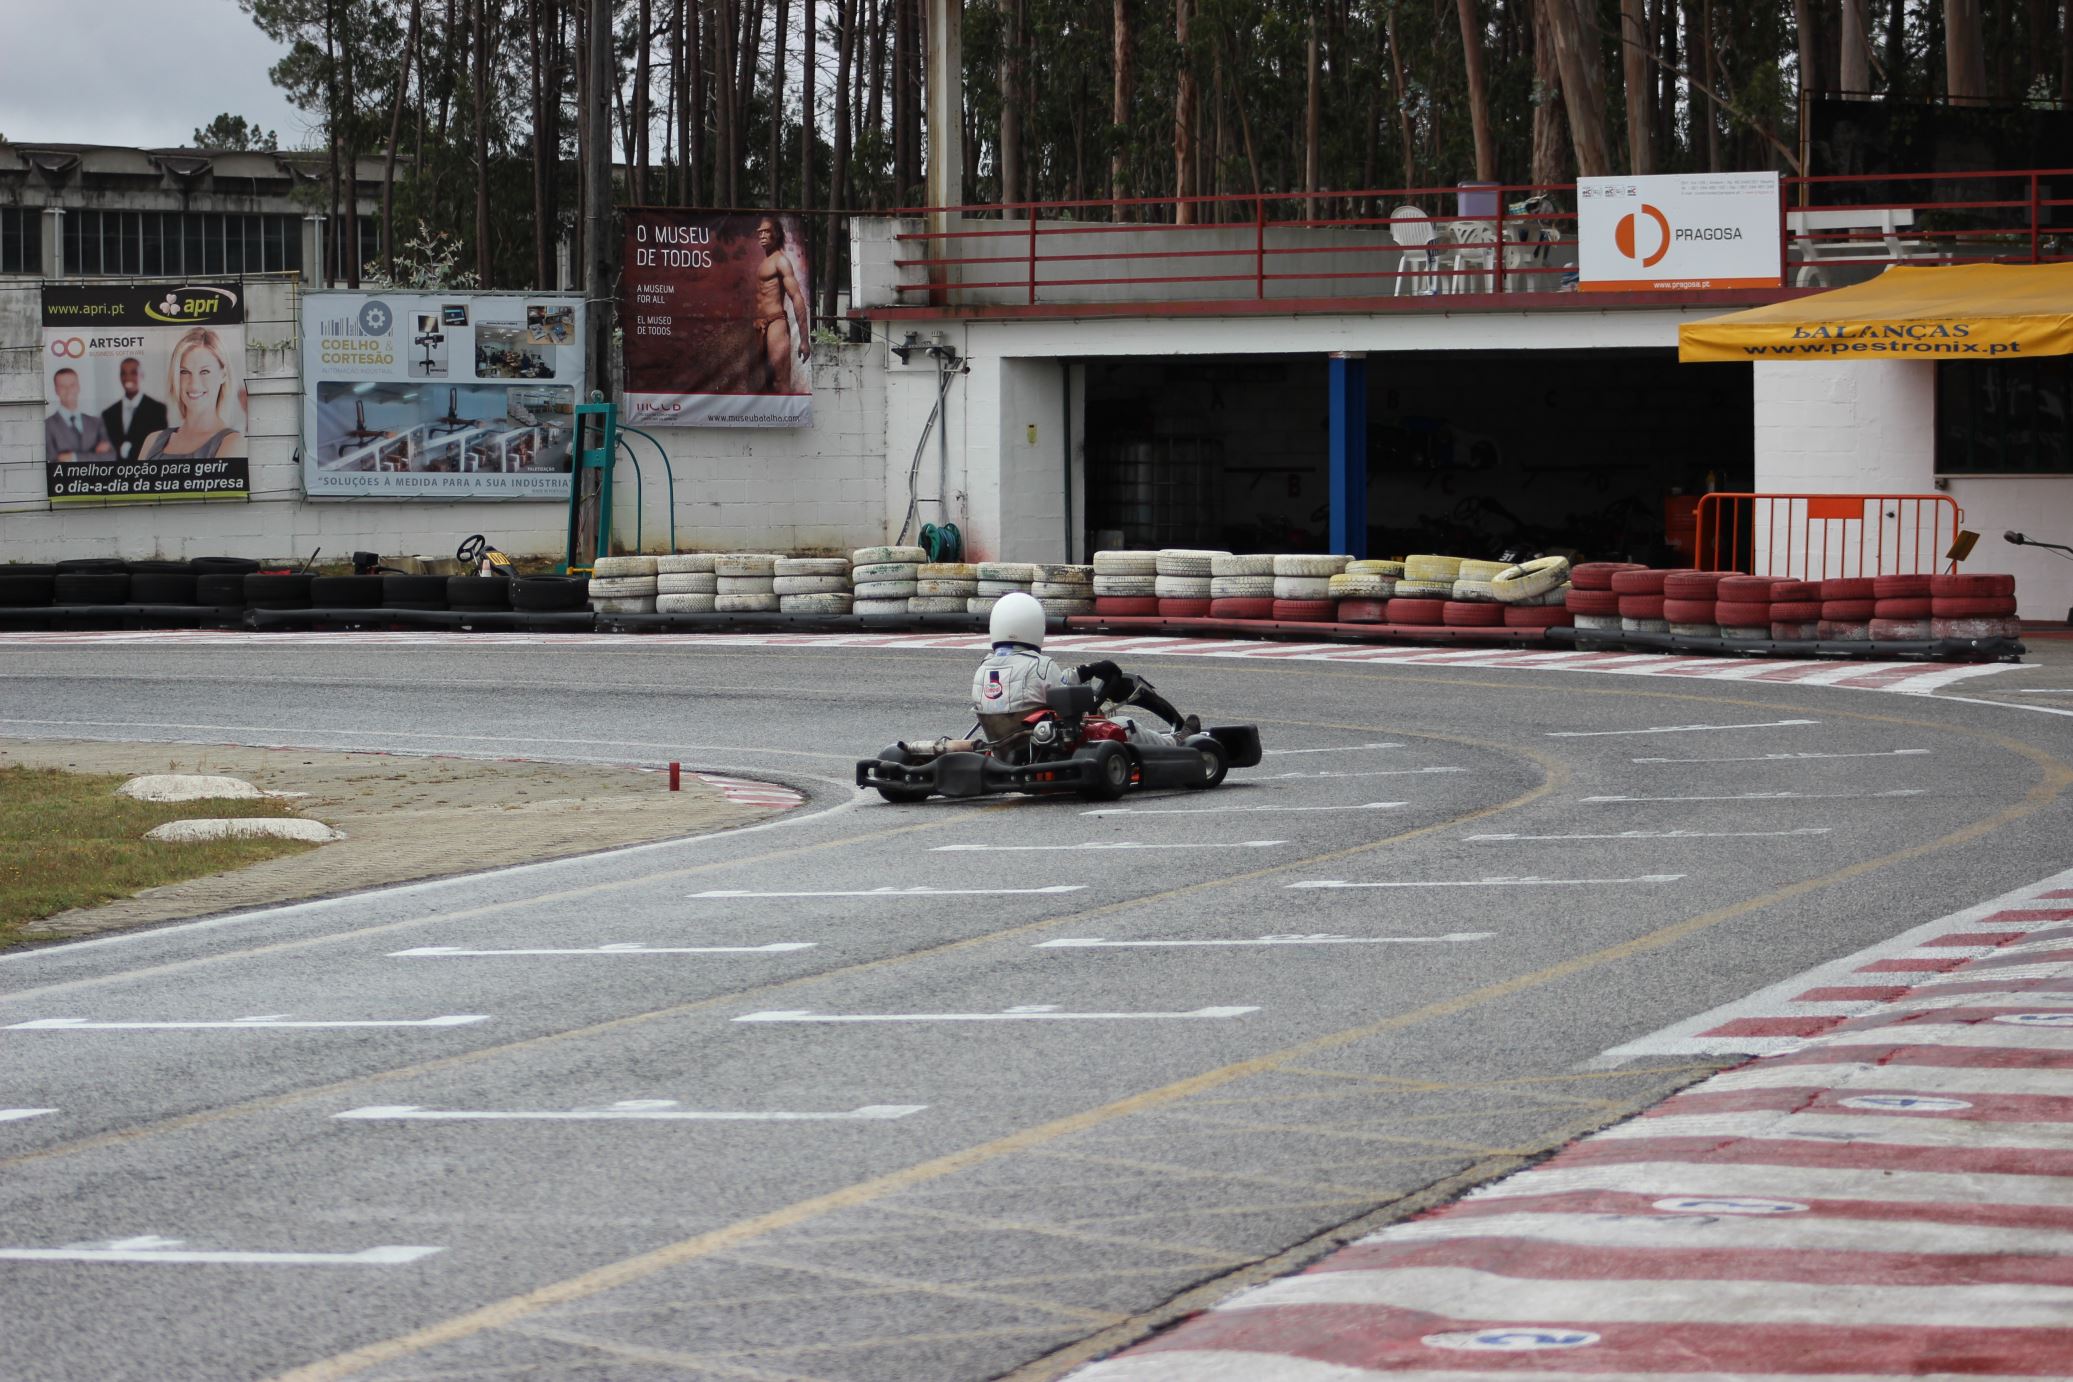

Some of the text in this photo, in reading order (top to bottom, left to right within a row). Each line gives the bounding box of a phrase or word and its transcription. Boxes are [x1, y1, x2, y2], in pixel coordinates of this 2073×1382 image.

[637, 225, 709, 244] O MUSEU
[1675, 227, 1742, 241] PRAGOSA
[637, 249, 712, 268] DE TODOS
[637, 284, 675, 294] A MUSEUM
[1653, 281, 1711, 289] www.pragosa.pt
[183, 294, 219, 317] apri
[637, 295, 665, 304] FOR ALL
[48, 303, 124, 317] www.apri.pt
[637, 316, 672, 325] EL MUSEO
[637, 327, 672, 336] DE TODOS
[89, 336, 144, 348] ARTSOFT
[321, 339, 380, 351] COELHO
[1744, 341, 2021, 355] www.pestronix.pt
[321, 351, 394, 365] CORTESÃO
[53, 460, 229, 478] A melhor opção para gerir
[55, 477, 244, 494] o dia-a-dia da sua empresa
[384, 476, 391, 486] À
[396, 478, 438, 487] MEDIDA
[443, 478, 470, 487] PARA
[475, 478, 483, 487] A
[486, 478, 507, 487] SUA
